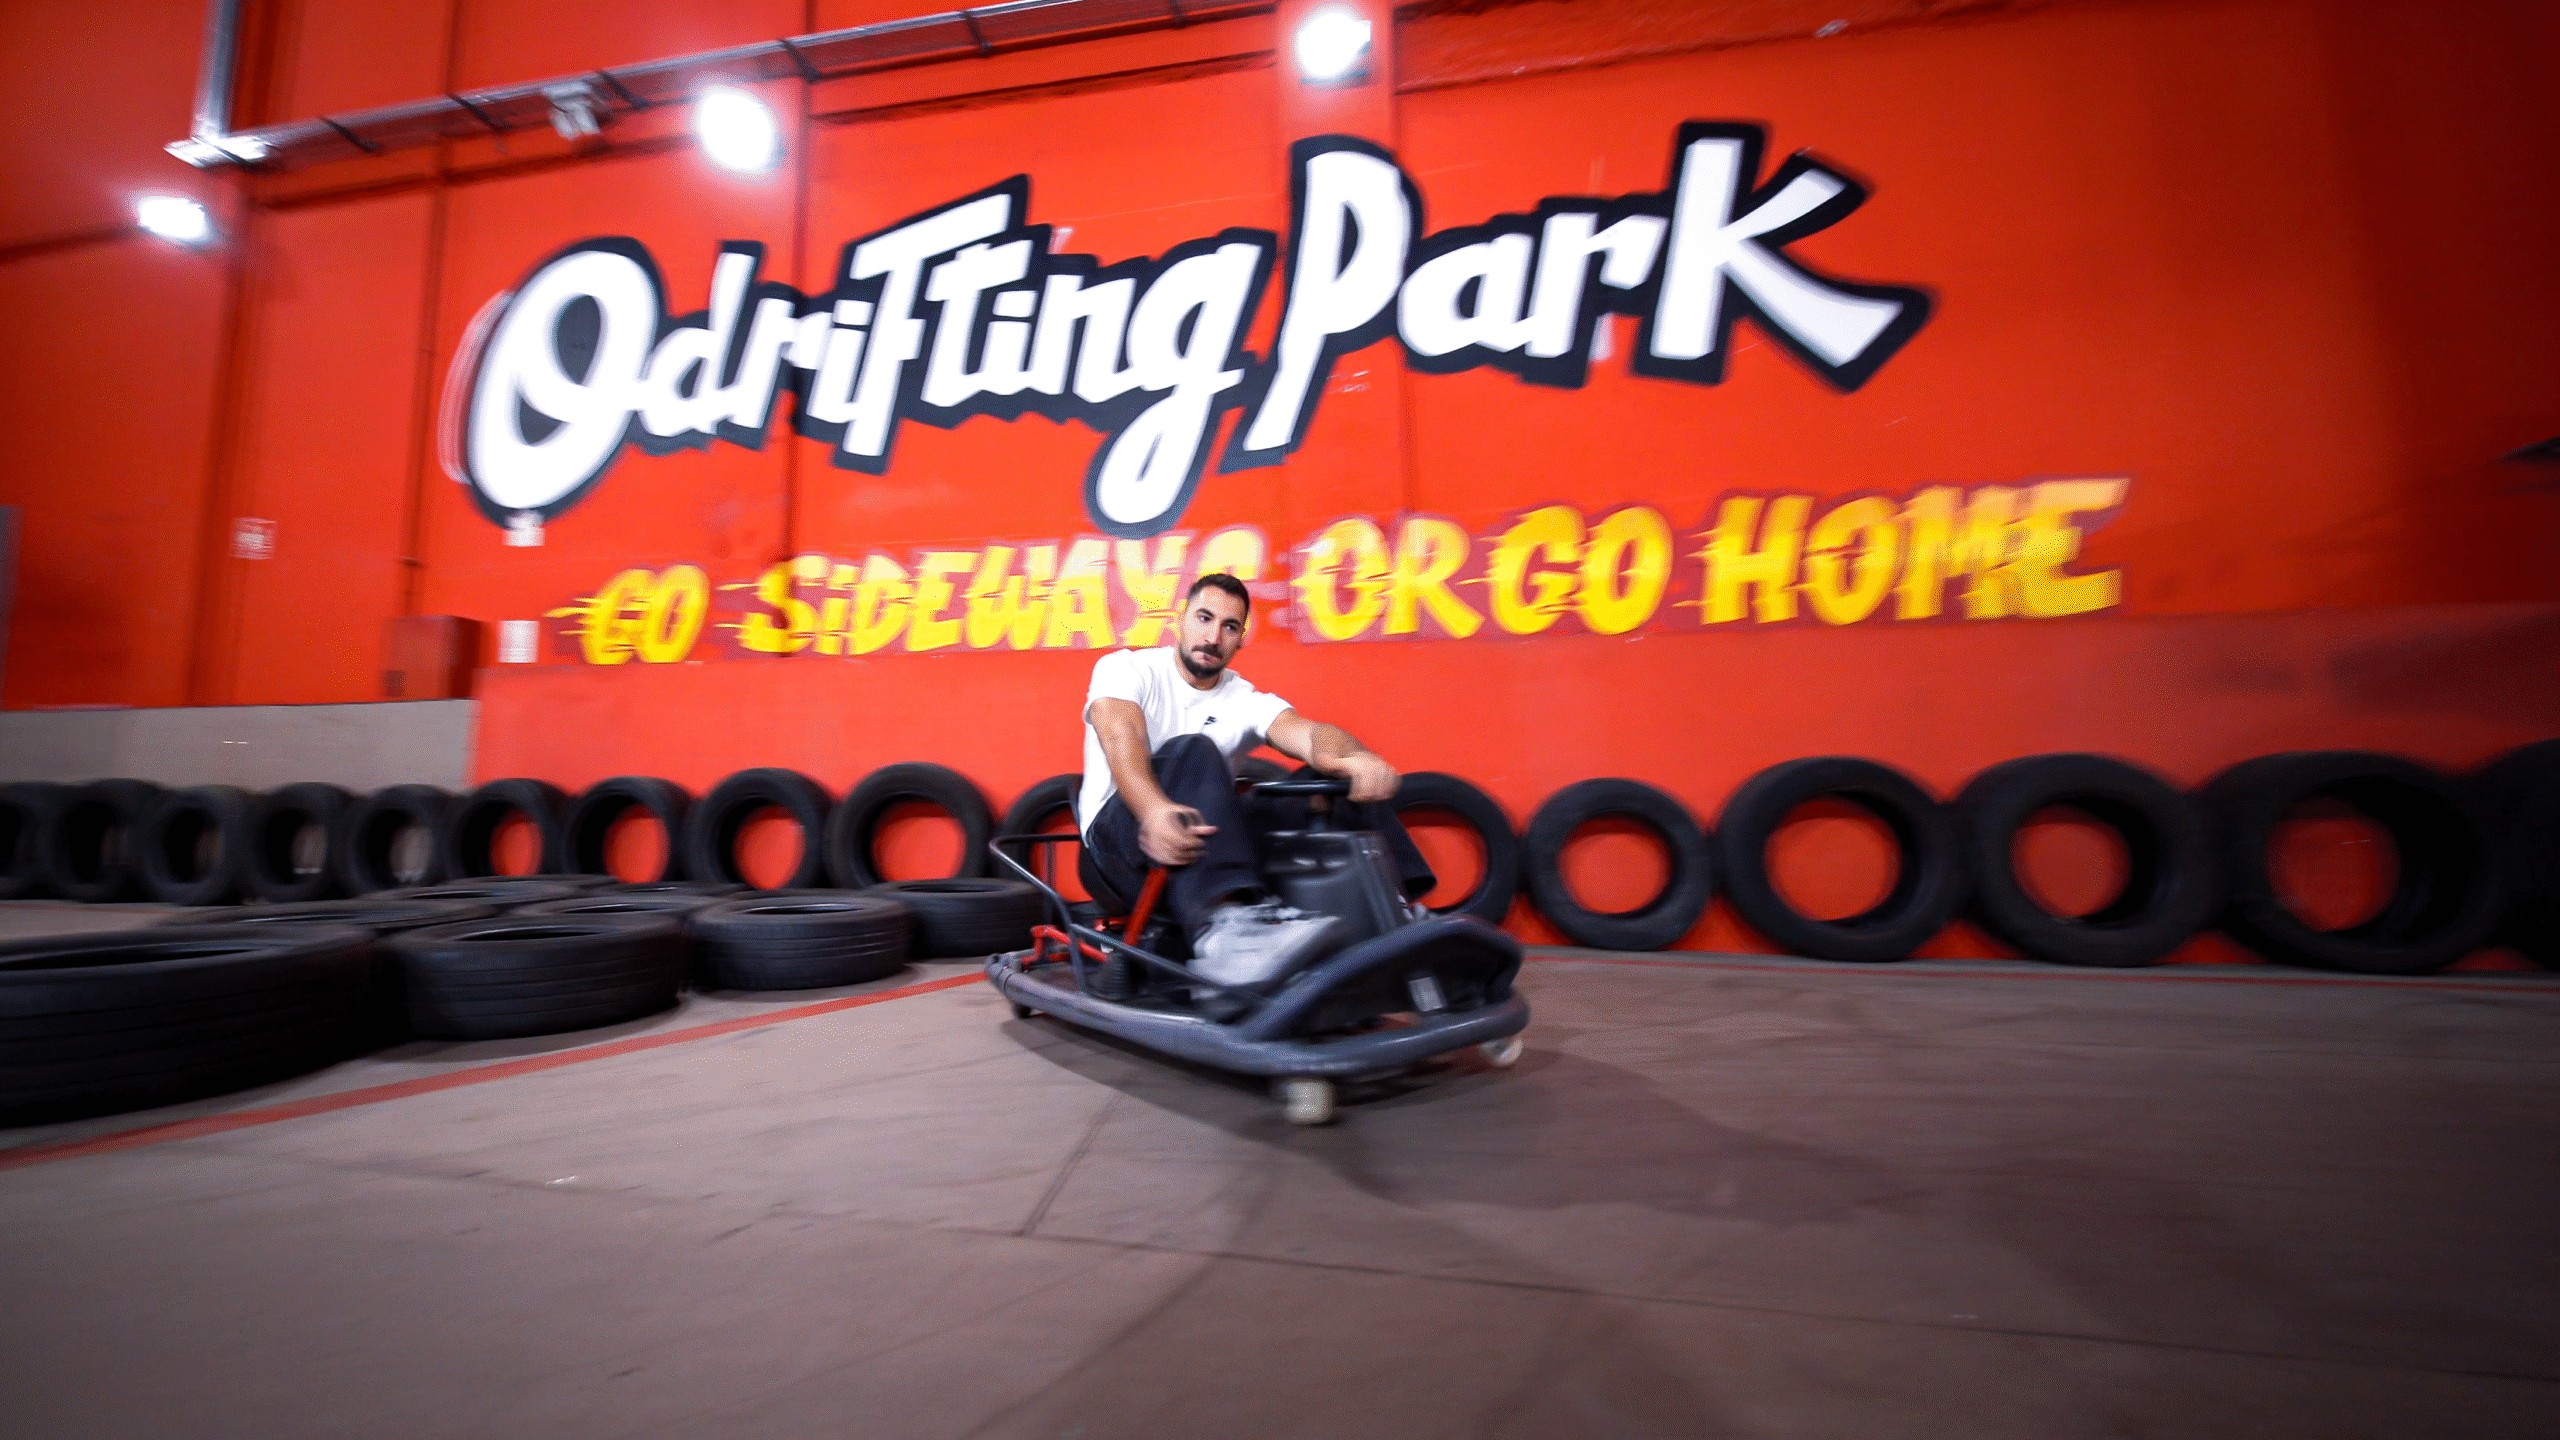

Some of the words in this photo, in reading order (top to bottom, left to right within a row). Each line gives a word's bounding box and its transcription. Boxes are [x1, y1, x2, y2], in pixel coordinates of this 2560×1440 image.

[562, 562, 710, 665] GO
[1296, 515, 1484, 641] OR
[1482, 504, 1672, 635] GO
[1698, 476, 2131, 627] HOME
